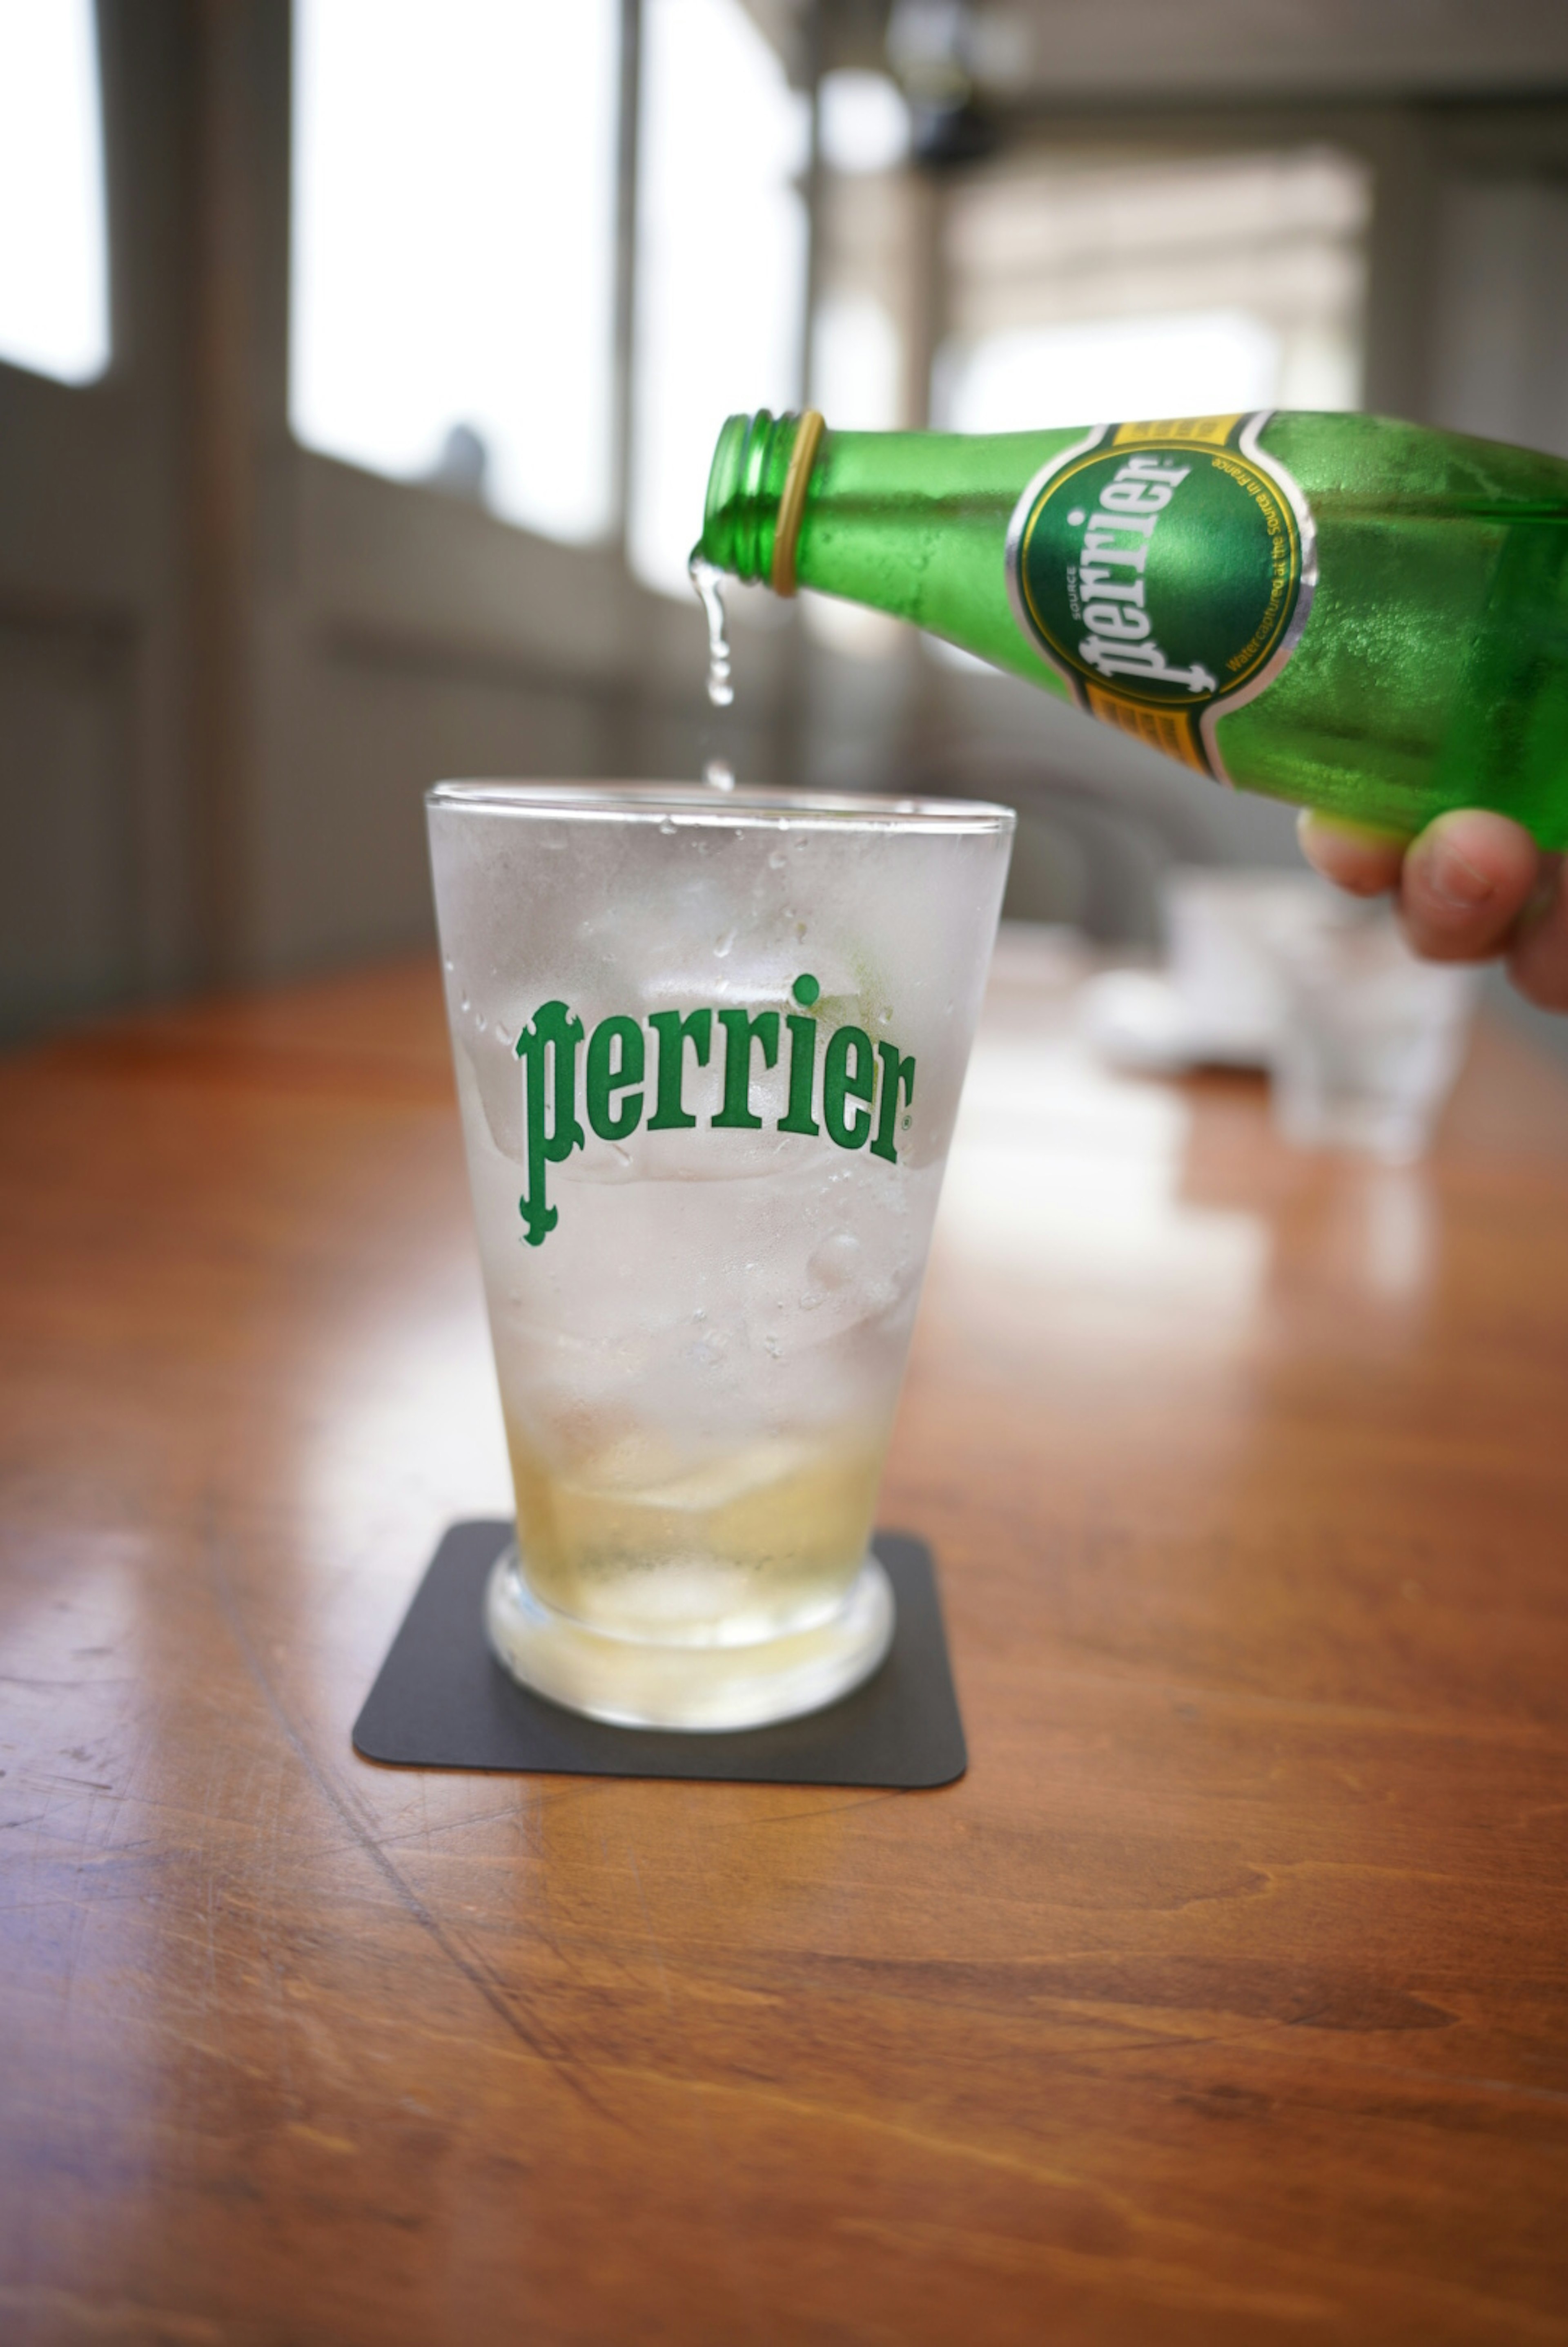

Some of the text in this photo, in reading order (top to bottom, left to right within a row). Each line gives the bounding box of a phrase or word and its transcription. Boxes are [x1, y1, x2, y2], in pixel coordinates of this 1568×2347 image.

[1067, 565, 1082, 620] SOURCE
[1212, 457, 1286, 671] Water captured at the Source in France
